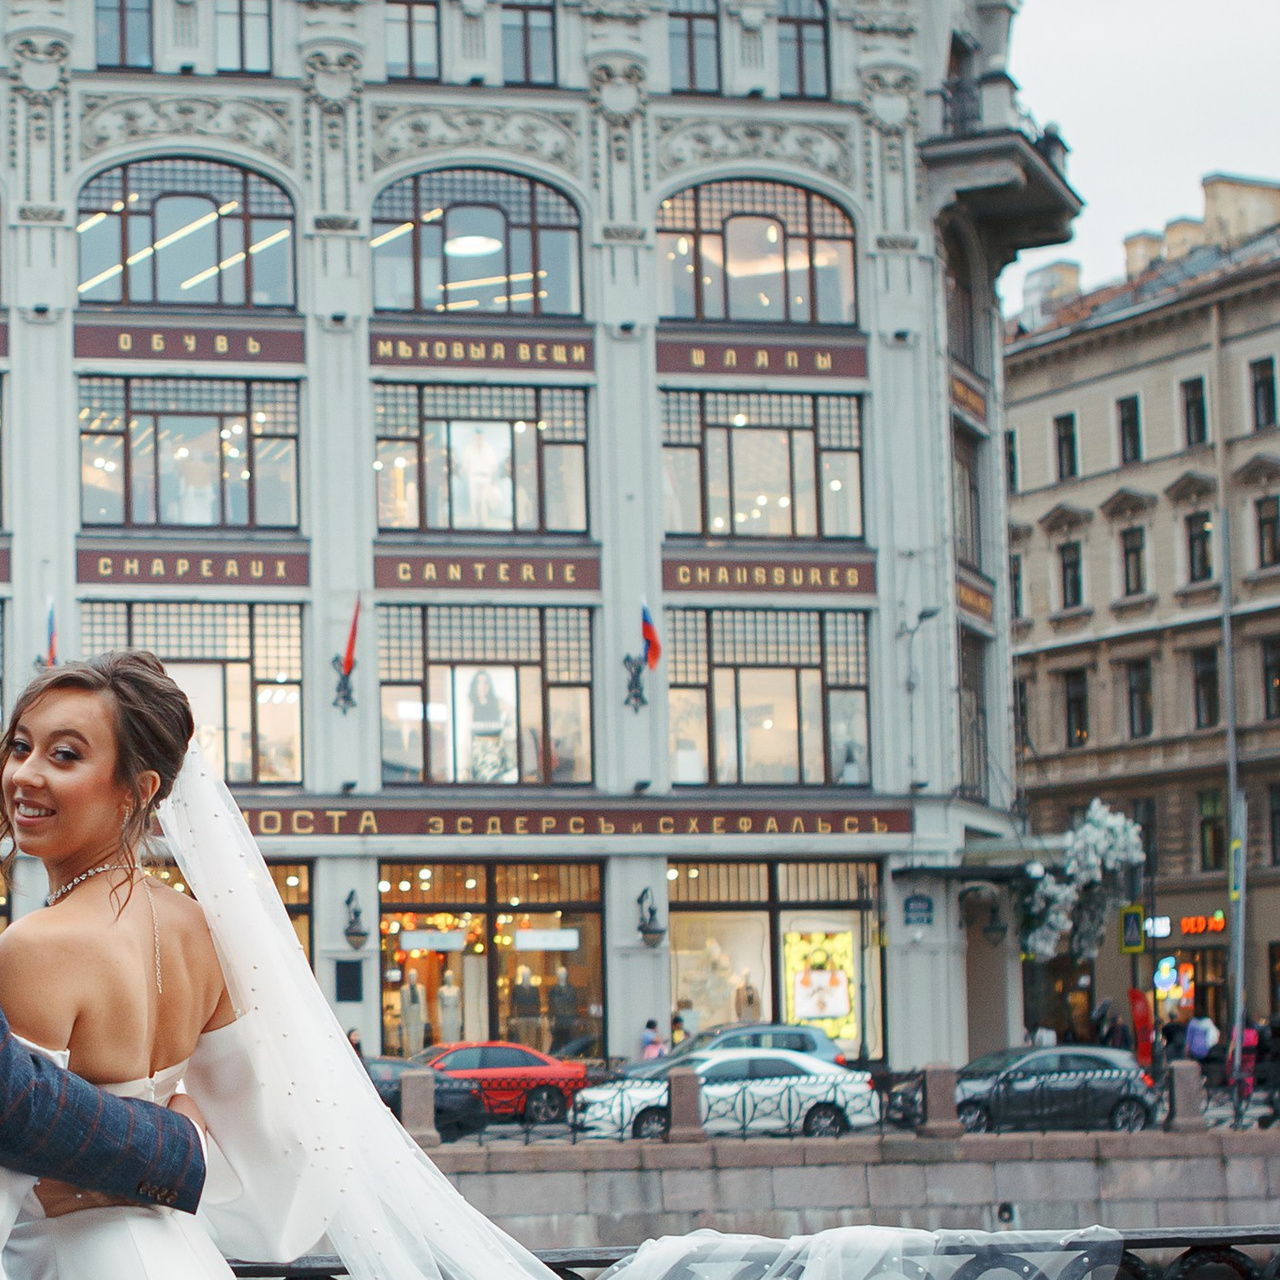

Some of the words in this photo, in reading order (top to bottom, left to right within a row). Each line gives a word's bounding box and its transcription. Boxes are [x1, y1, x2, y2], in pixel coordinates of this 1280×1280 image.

[119, 334, 260, 354] ОБУВЬ
[519, 344, 584, 362] ВЕЩИ
[692, 349, 831, 370] ШЛЯПЫ
[99, 558, 285, 578] CHAPEAUX
[679, 566, 858, 586] CHAUSSURES
[242, 811, 378, 834] ОСТА
[428, 817, 615, 835] ЭСДЕРСЪ
[659, 817, 888, 834] СХЕФАЛЬСЪ
